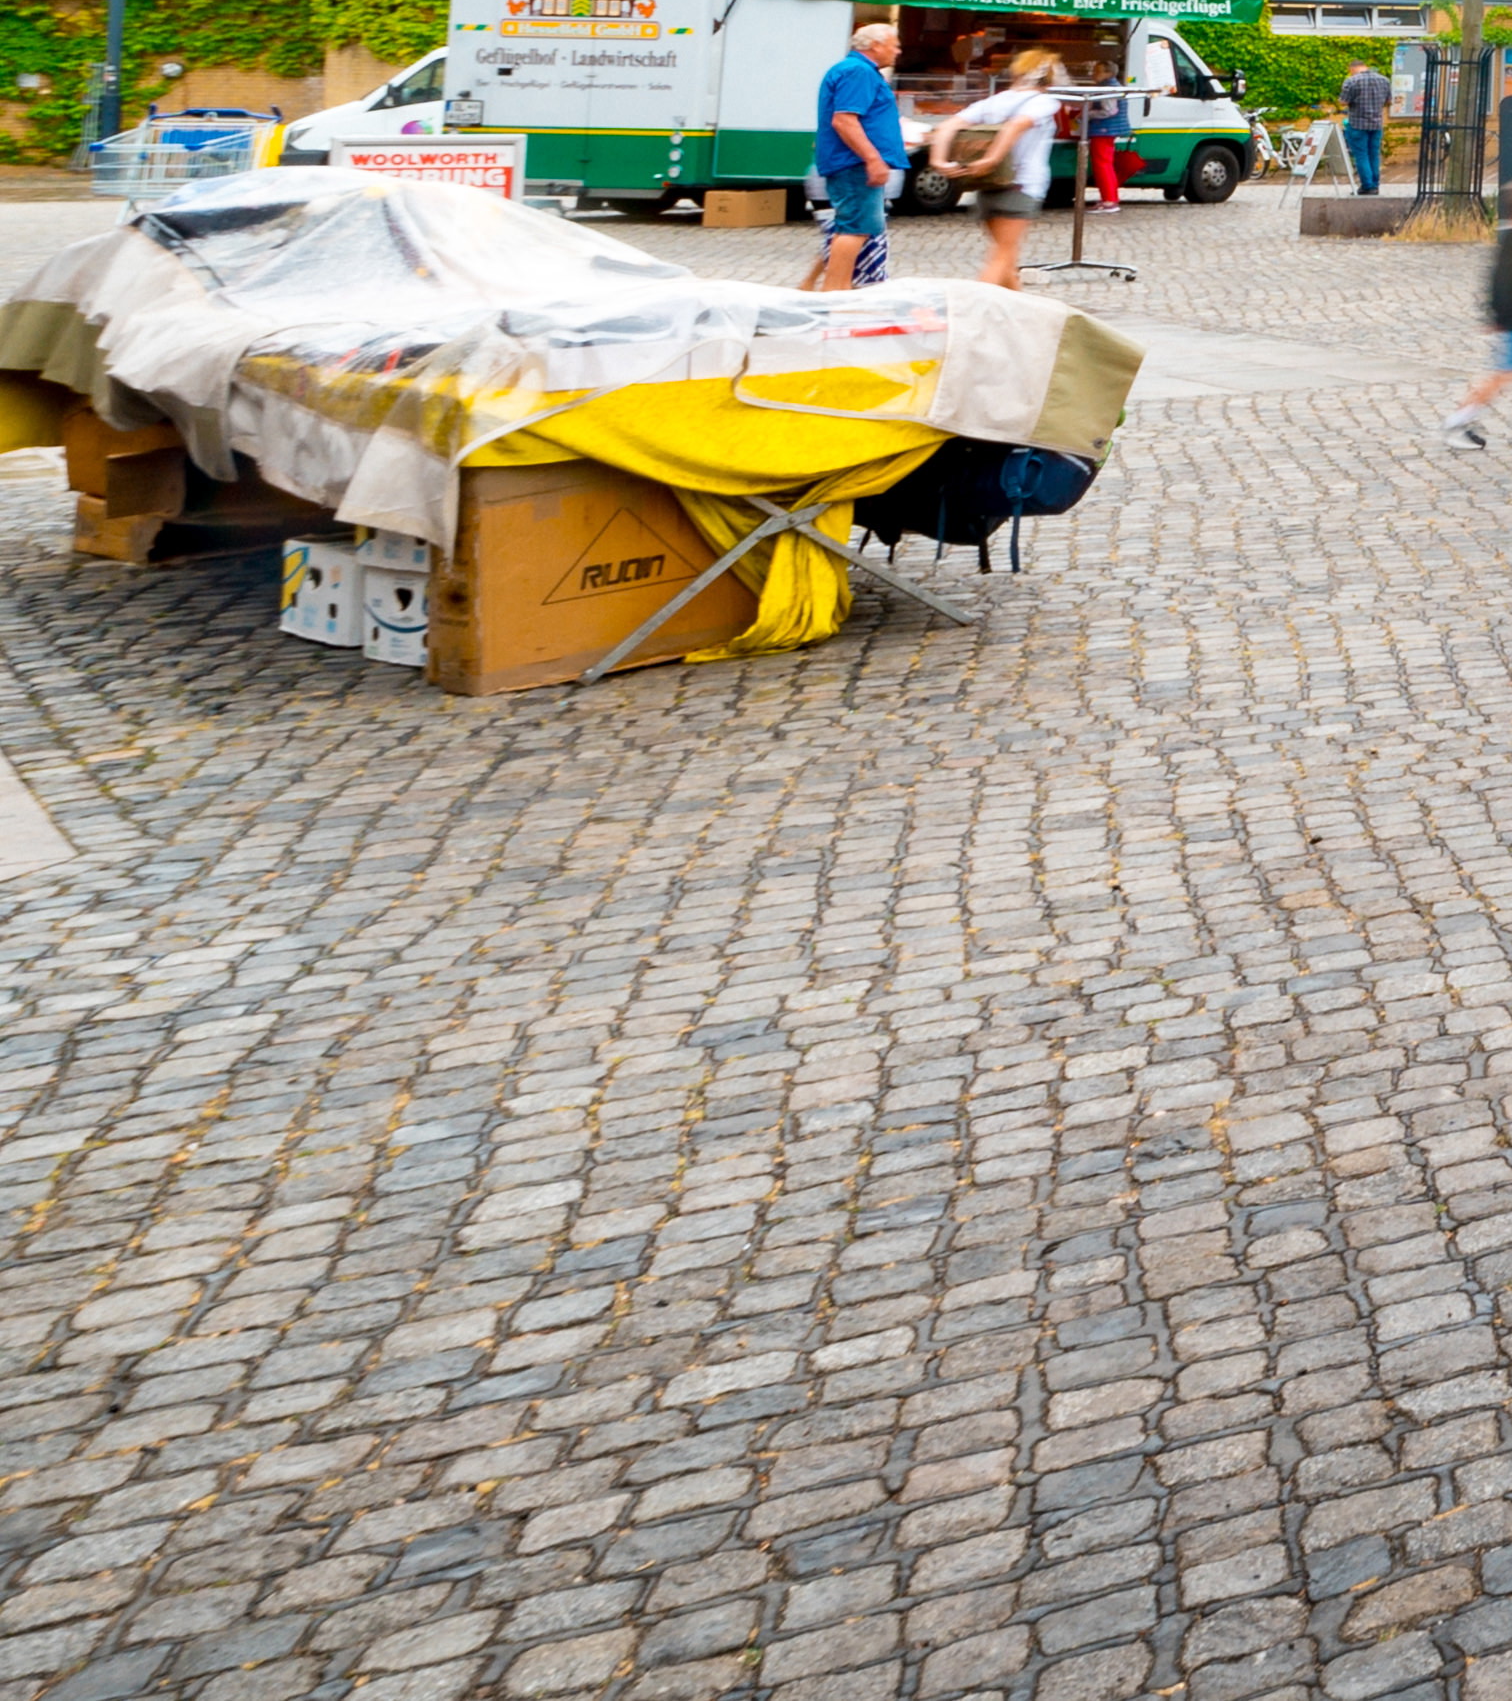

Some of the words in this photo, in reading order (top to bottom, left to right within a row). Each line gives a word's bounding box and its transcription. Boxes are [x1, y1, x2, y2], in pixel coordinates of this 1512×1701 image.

[476, 48, 559, 68] Geflügelhof
[571, 49, 678, 68] Landwirtschaft
[350, 152, 498, 166] WOOLWORTH
